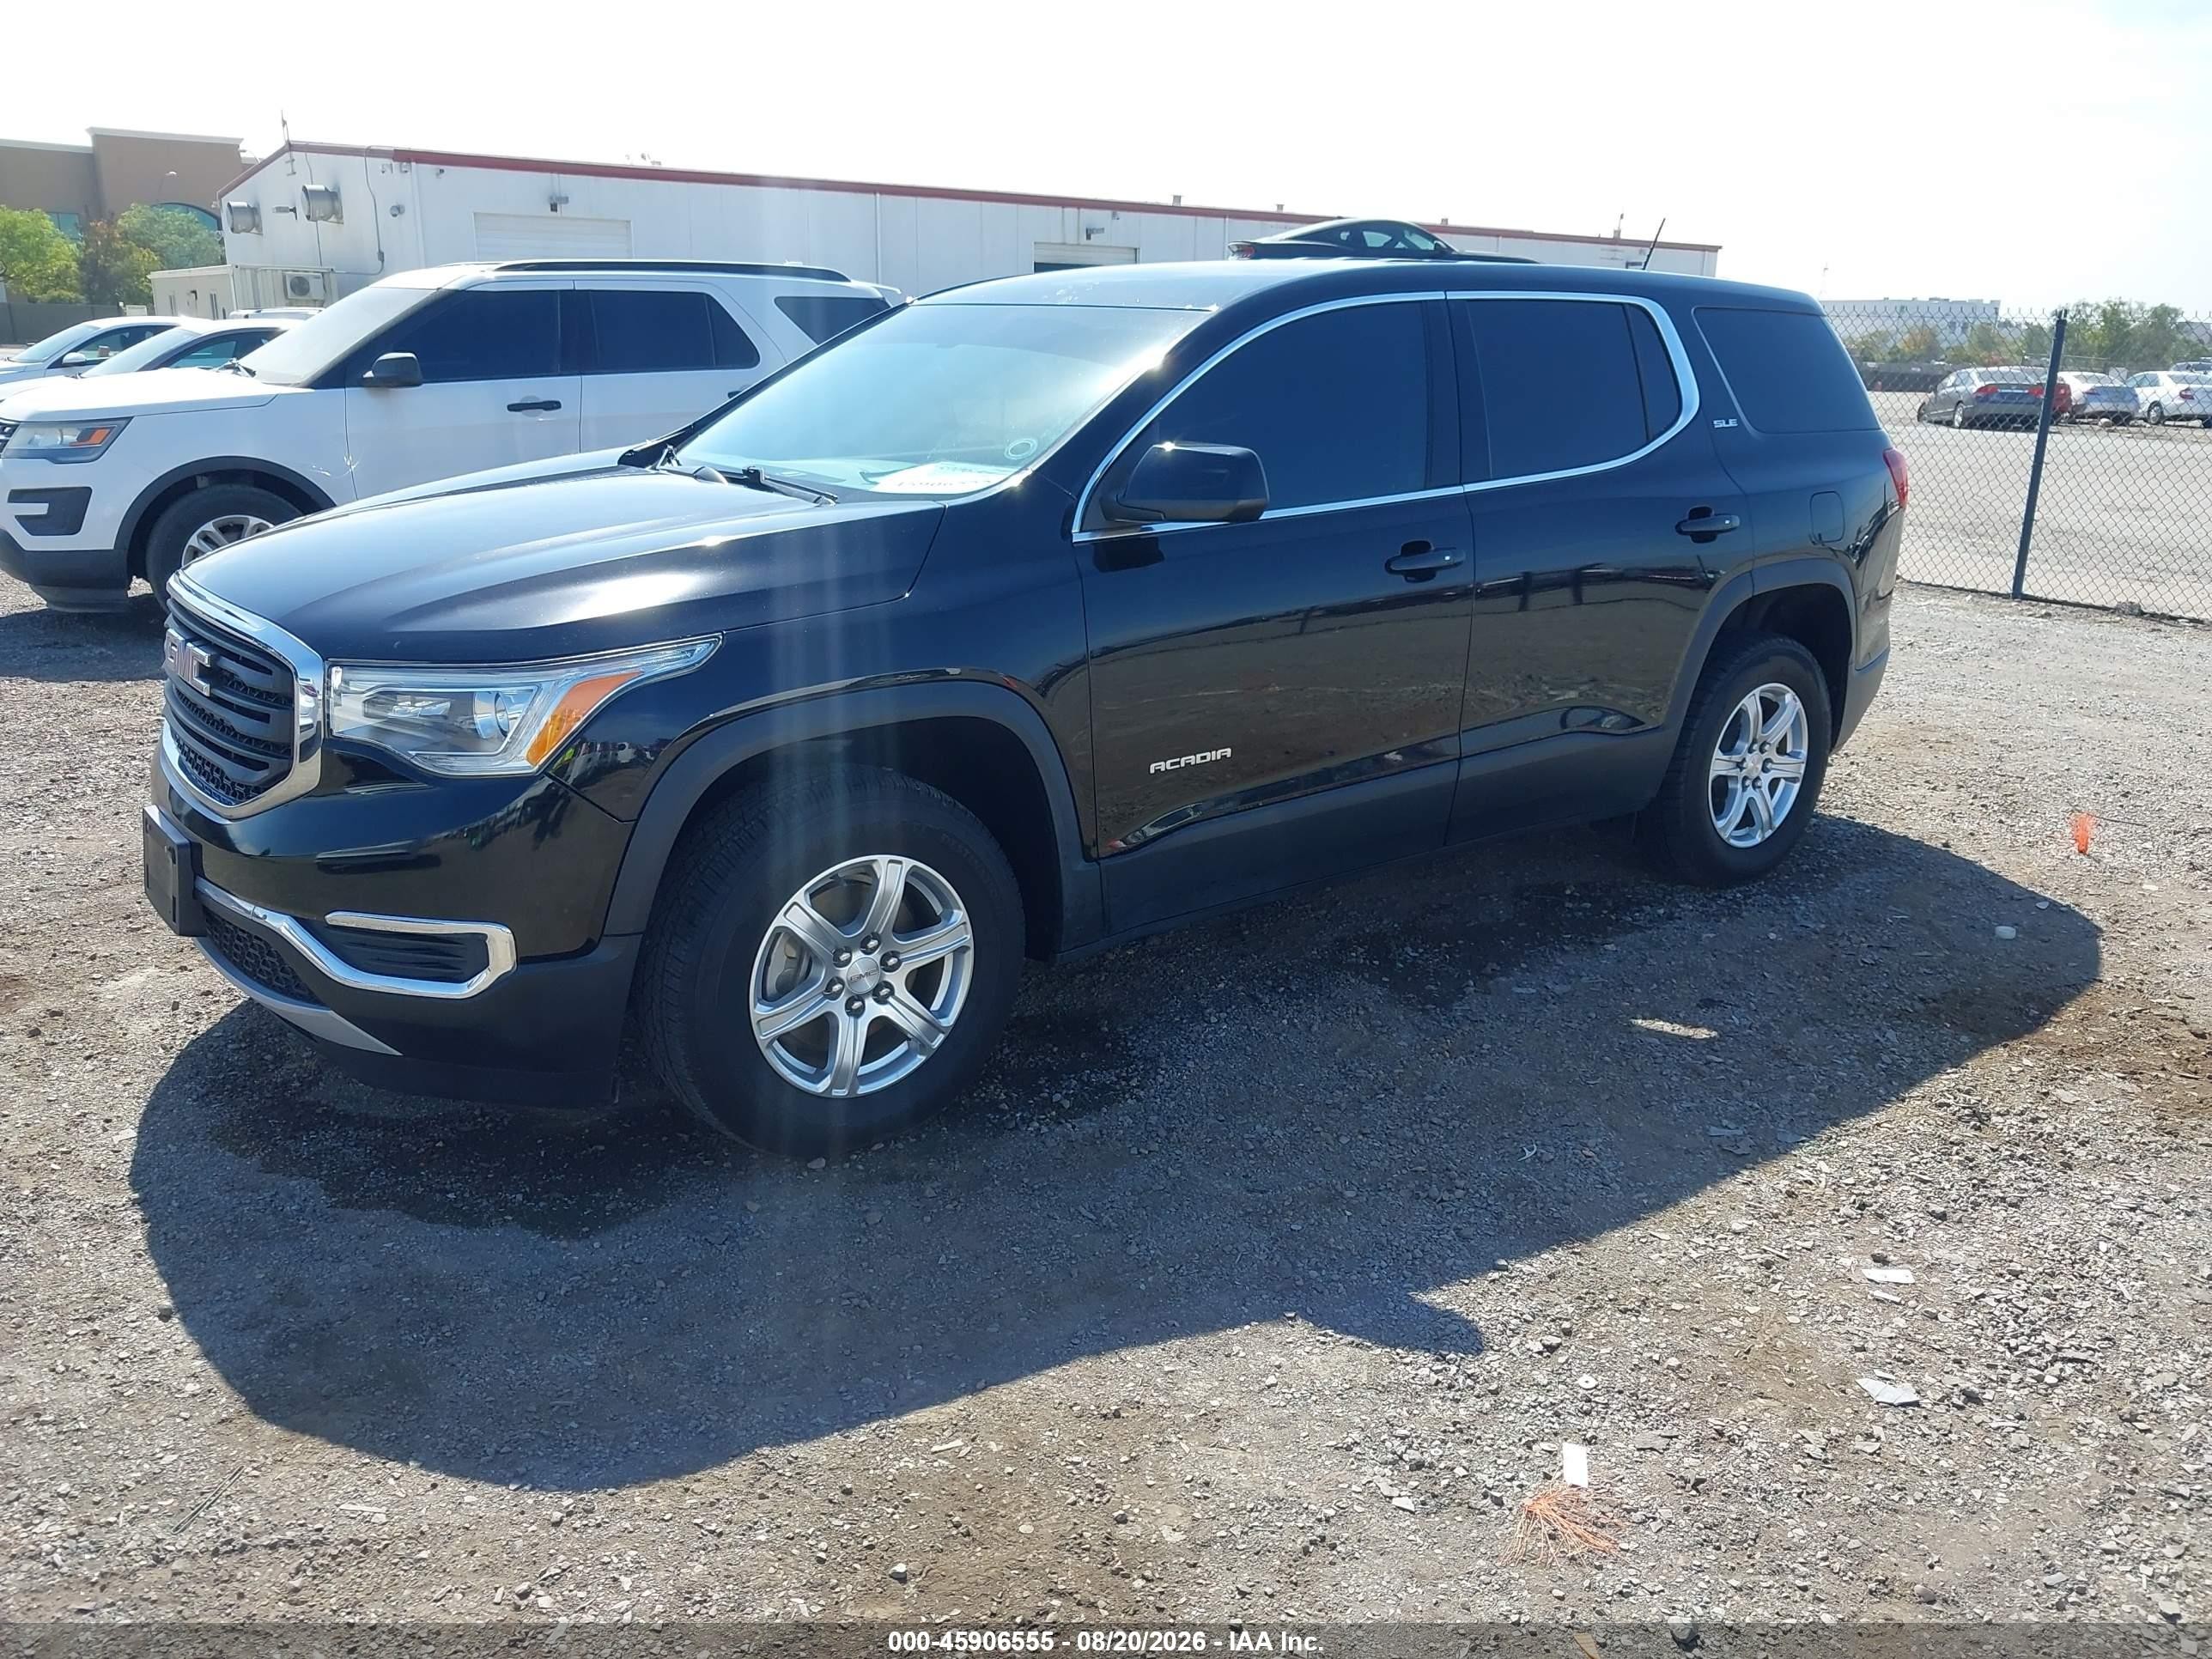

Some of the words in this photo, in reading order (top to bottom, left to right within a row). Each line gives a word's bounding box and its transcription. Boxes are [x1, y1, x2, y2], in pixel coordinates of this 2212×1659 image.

[1712, 418, 1739, 428] SLE
[164, 629, 211, 697] GMC
[1149, 746, 1232, 774] ACADIA
[850, 968, 878, 983] GMC
